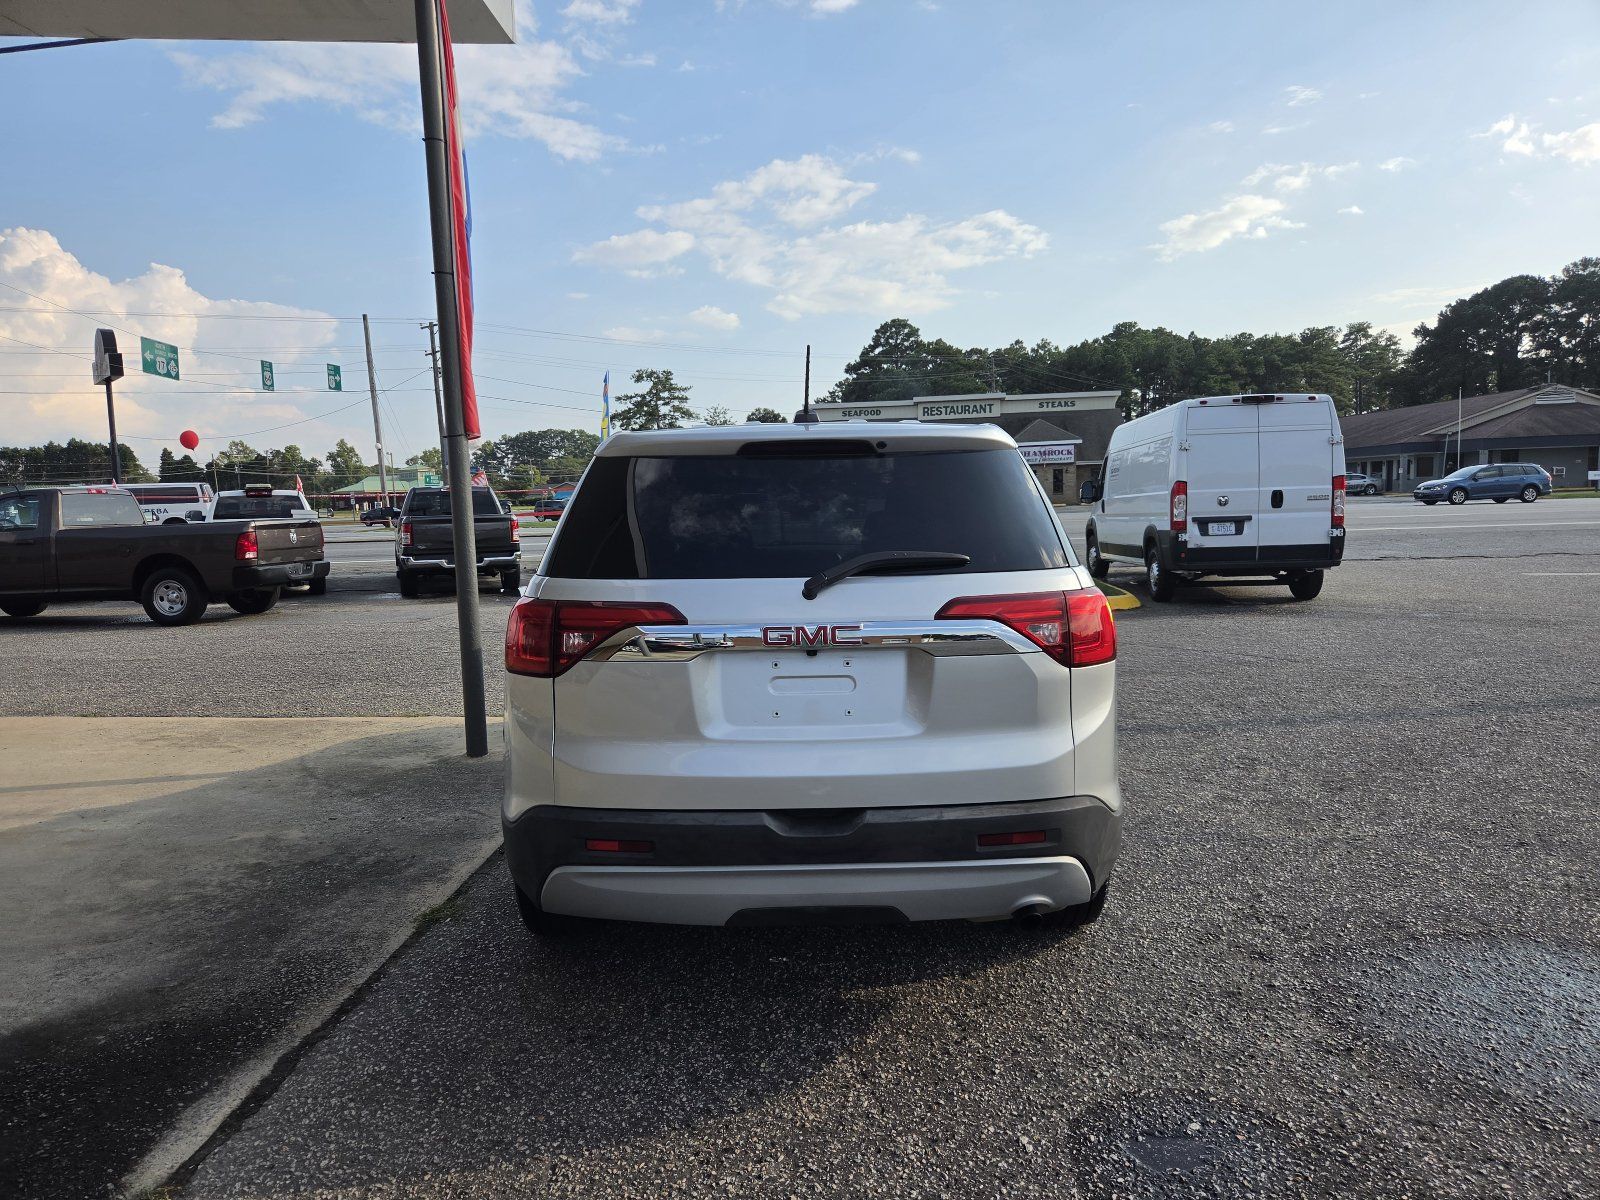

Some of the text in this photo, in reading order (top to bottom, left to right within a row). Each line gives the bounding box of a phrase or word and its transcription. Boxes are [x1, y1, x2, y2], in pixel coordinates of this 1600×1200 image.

[157, 360, 166, 370] 17
[1038, 400, 1075, 409] STEAKS
[842, 409, 882, 418] SEAFOOD
[922, 403, 994, 417] RESTAURANT
[1021, 449, 1074, 458] HAMROCK
[761, 625, 863, 647] GMC
